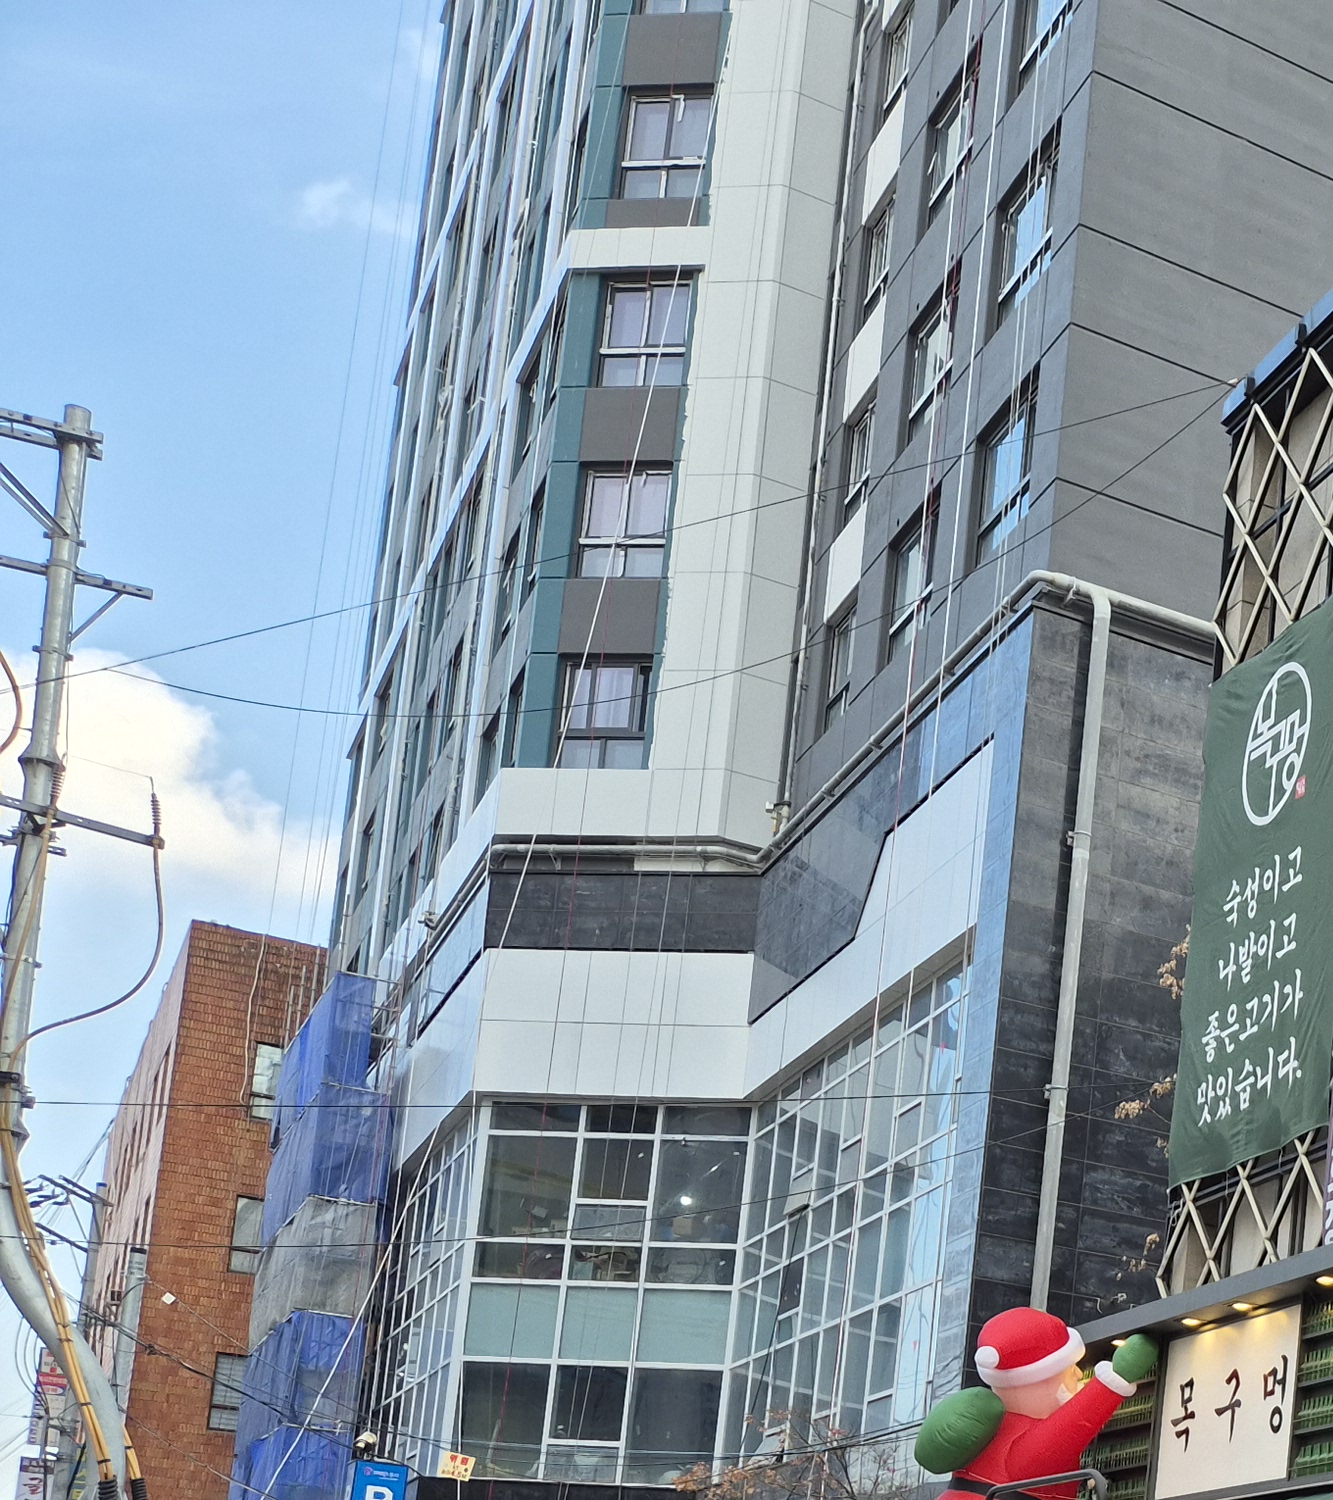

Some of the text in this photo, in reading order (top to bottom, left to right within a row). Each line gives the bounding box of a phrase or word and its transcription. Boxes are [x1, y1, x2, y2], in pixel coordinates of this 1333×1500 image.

[1225, 845, 1303, 929] 숙성이고
[1218, 911, 1297, 992] 나발이고
[1196, 1046, 1303, 1128] 맛있습니다.
[1170, 1354, 1290, 1453] 목구멍
